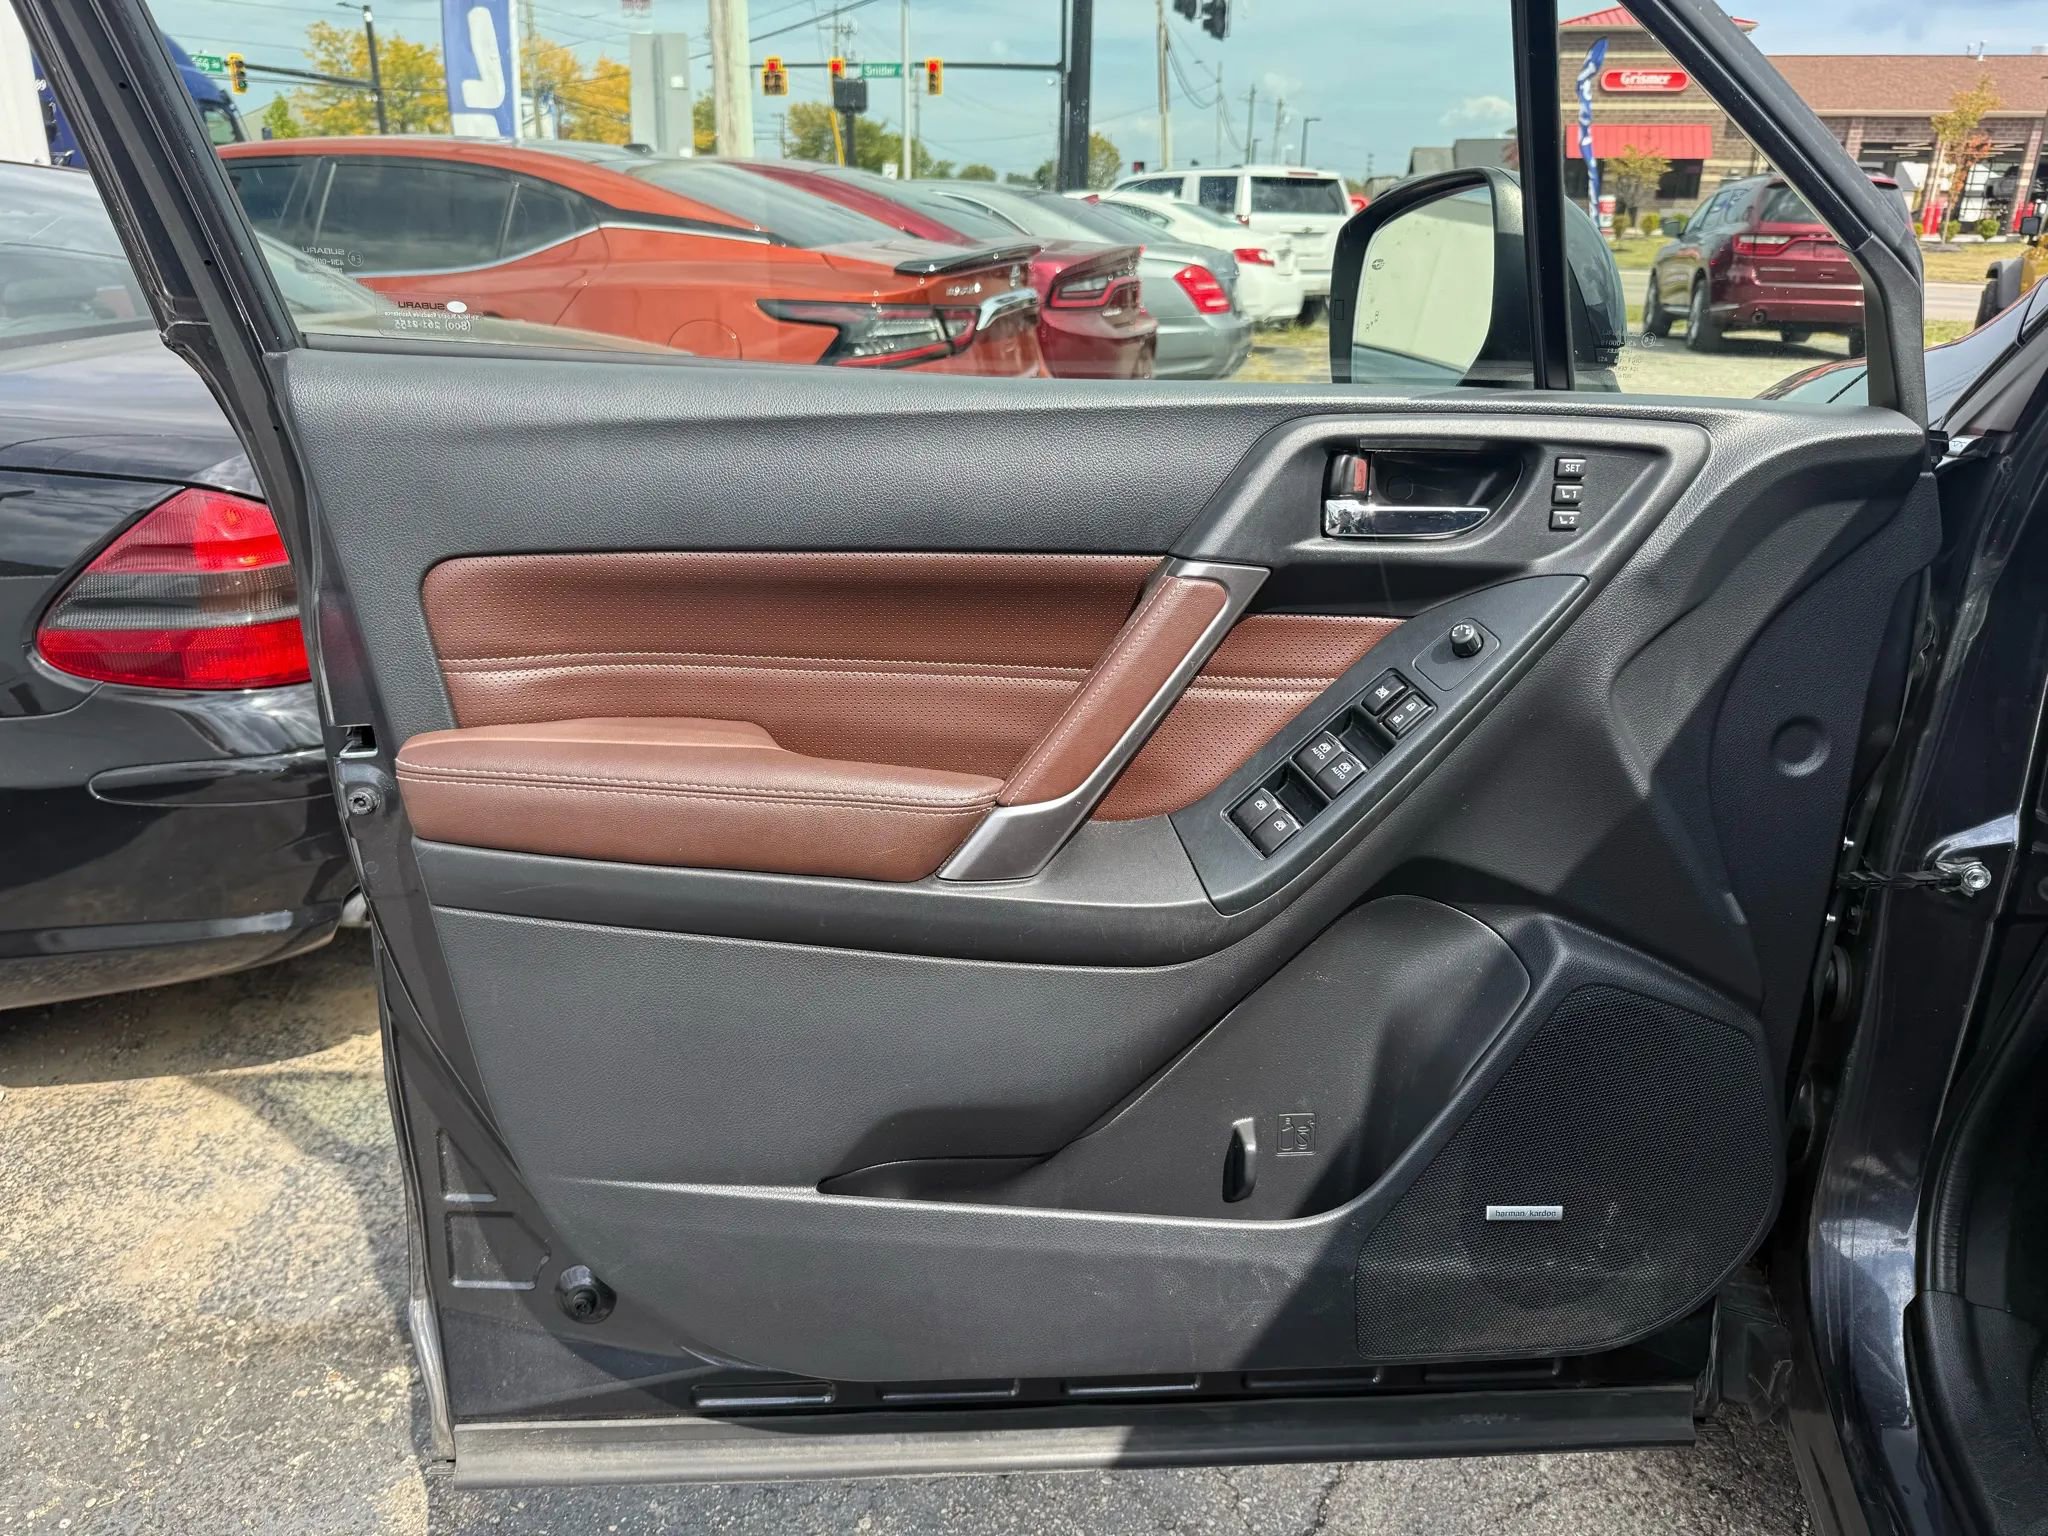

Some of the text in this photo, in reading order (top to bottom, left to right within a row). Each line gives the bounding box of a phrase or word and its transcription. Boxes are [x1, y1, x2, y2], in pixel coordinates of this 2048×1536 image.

[1565, 463, 1581, 472] SET
[1311, 747, 1326, 760] AUTO
[1331, 766, 1346, 780] AUTO
